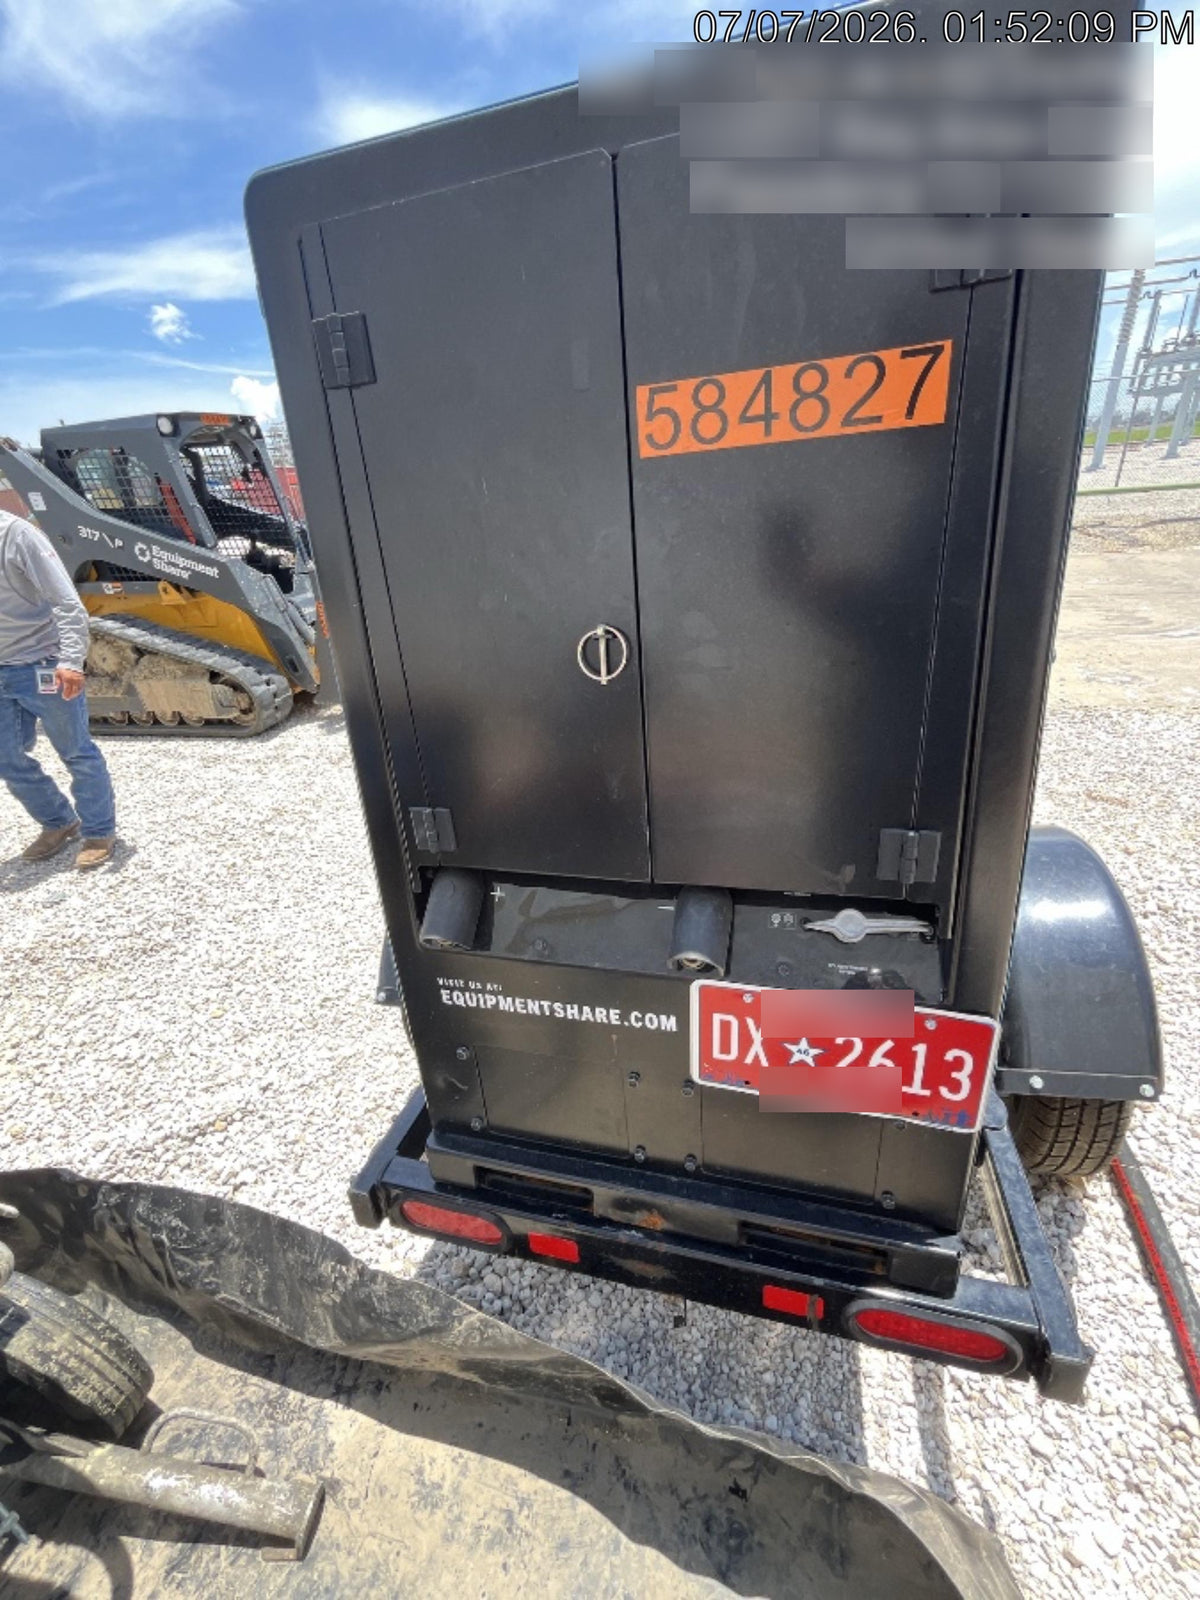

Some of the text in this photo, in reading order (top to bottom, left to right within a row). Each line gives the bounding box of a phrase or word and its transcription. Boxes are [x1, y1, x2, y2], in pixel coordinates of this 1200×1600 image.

[644, 343, 945, 451] 584827
[151, 544, 220, 579] Equipment
[436, 977, 465, 988] VISIT
[468, 980, 483, 990] US
[440, 989, 678, 1033] EQUIPMENTSHARE.COM
[712, 1012, 975, 1101] DX 2613
